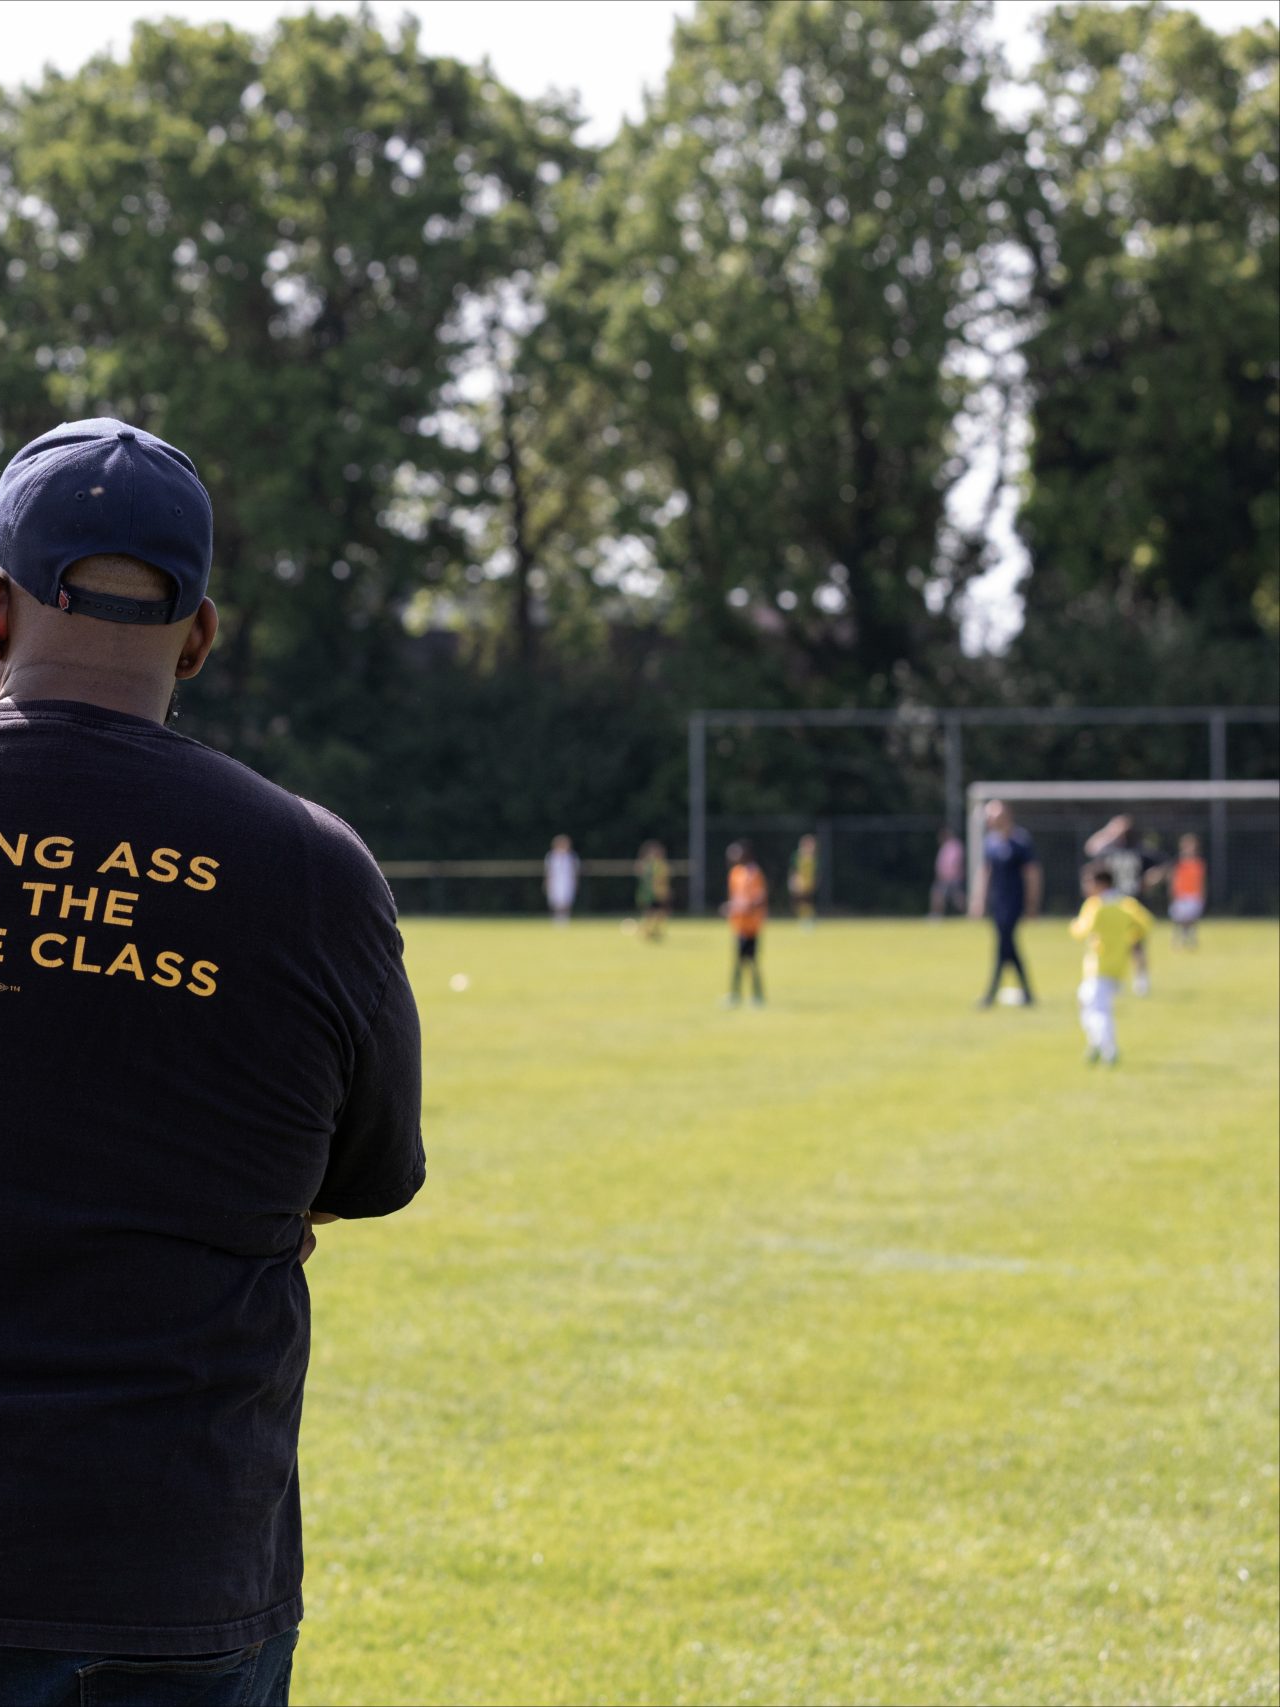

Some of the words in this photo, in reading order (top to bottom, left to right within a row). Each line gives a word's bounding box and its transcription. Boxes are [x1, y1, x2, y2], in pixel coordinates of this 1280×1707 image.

[96, 841, 220, 891] ASS
[22, 881, 140, 927] THE
[30, 932, 219, 997] CLASS
